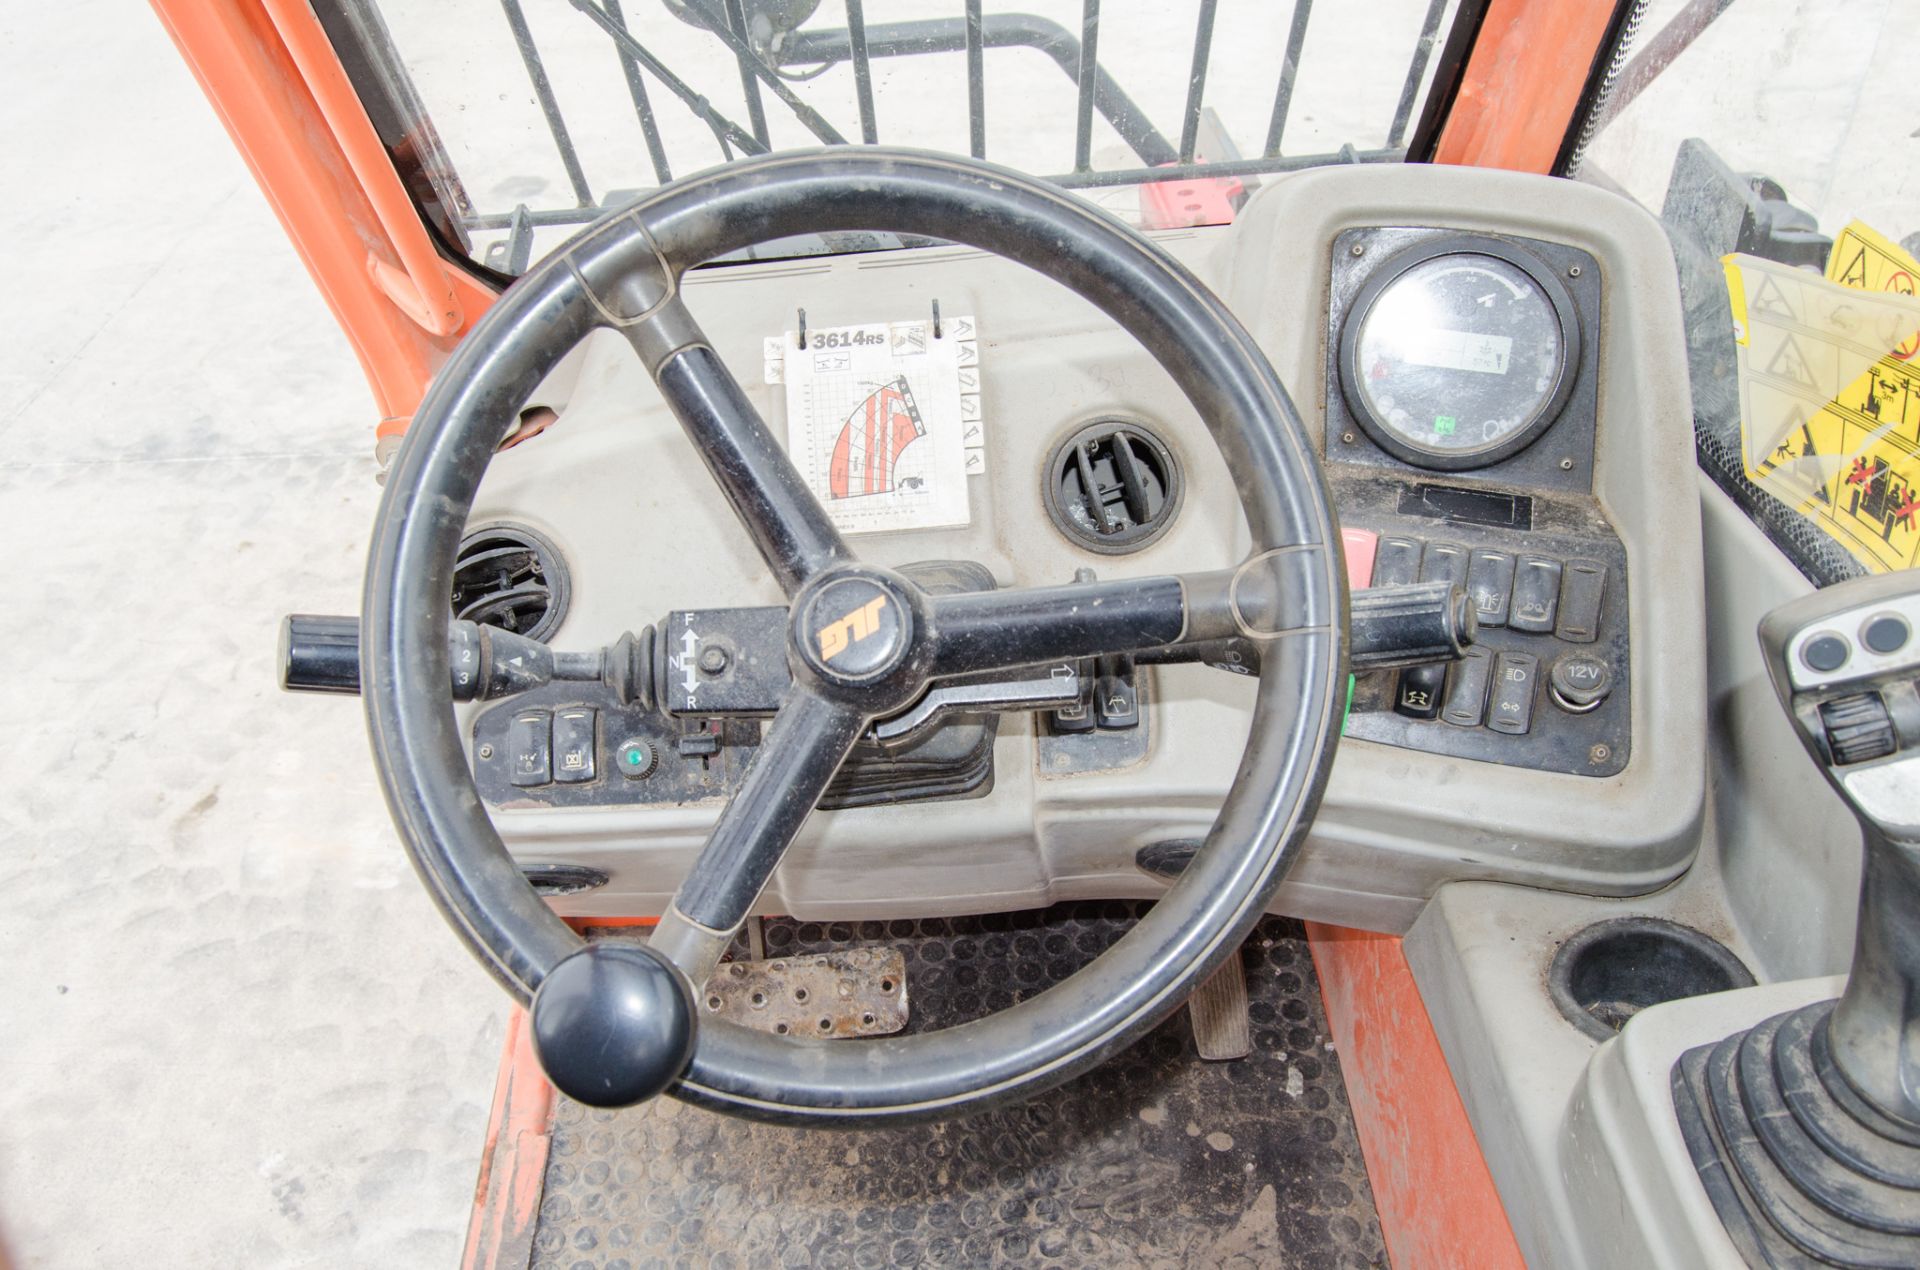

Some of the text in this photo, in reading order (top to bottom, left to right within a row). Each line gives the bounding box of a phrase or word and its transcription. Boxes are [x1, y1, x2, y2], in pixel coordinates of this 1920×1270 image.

[813, 330, 885, 349] 3614RS
[684, 613, 695, 626] F
[816, 594, 886, 662] JLG
[463, 631, 469, 641] 1
[462, 649, 471, 663] 2
[668, 655, 680, 669] N
[459, 672, 469, 685] 3
[1568, 665, 1600, 679] 12V
[687, 695, 697, 710] R
